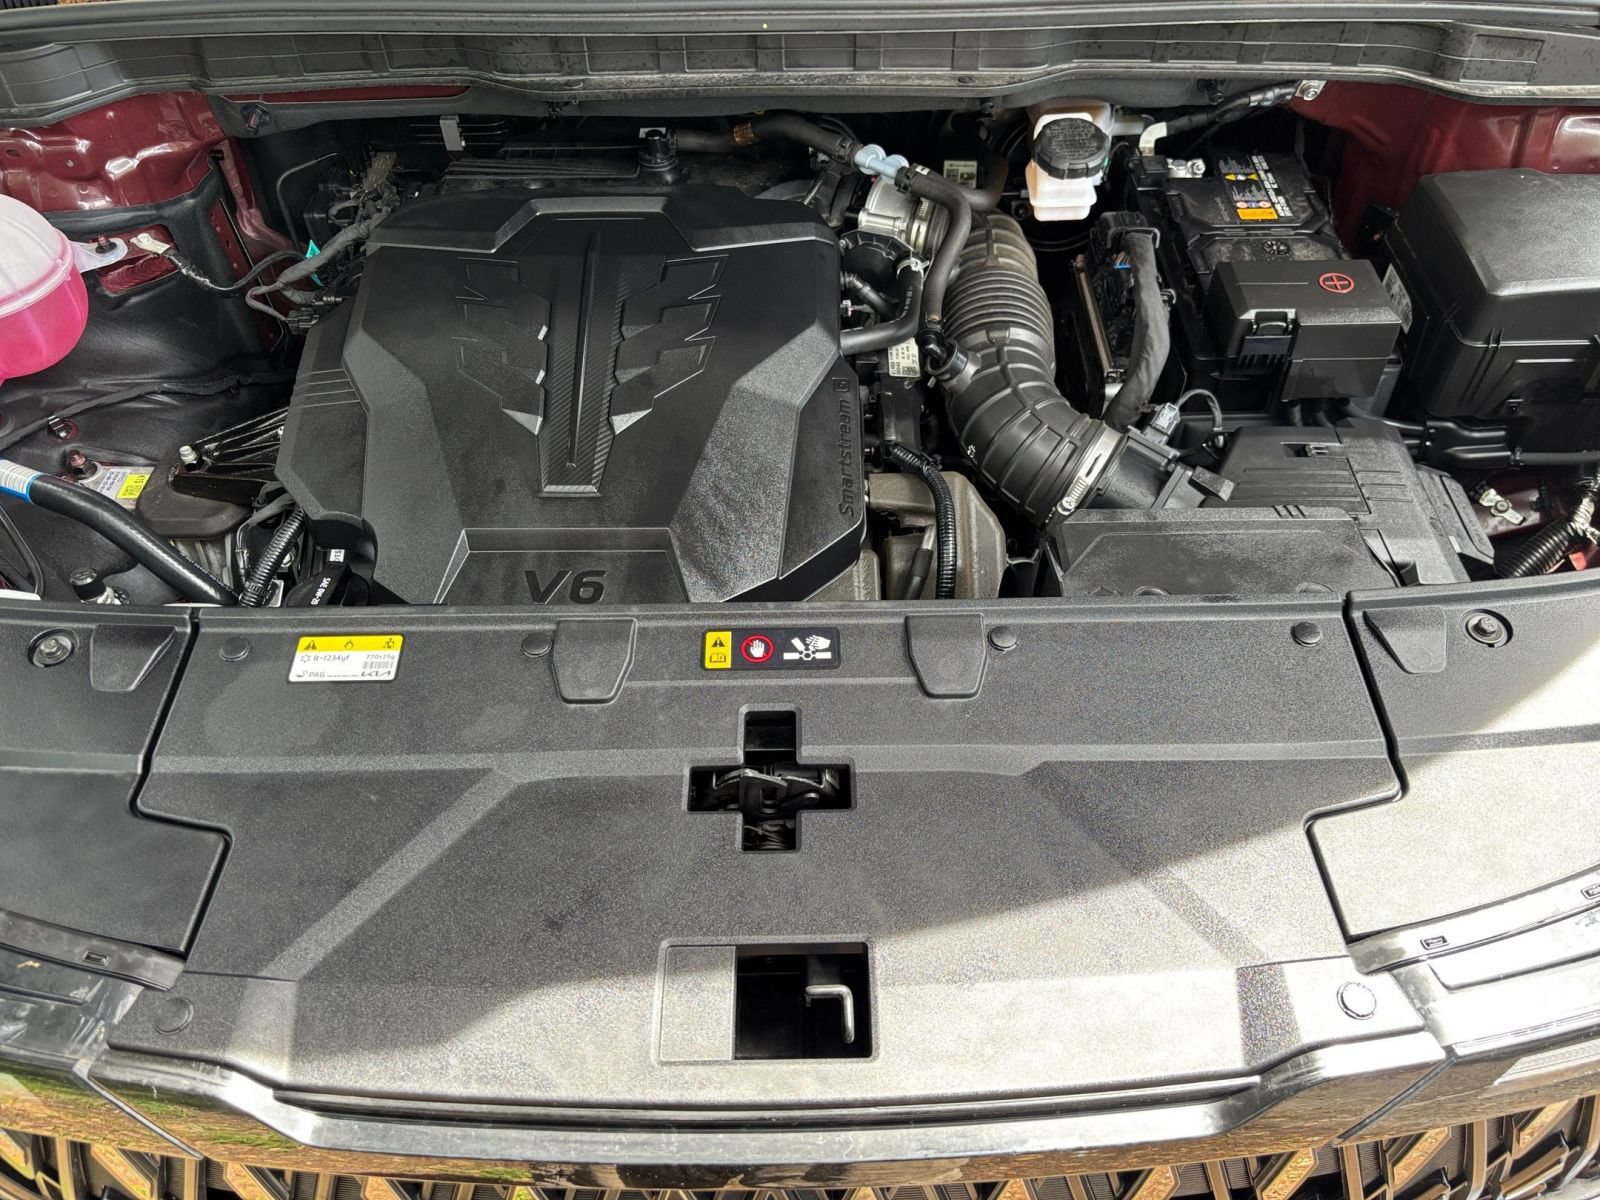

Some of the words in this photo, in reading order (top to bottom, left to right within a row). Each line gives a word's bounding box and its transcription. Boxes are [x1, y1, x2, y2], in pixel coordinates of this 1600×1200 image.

[838, 397, 854, 518] Smartstream
[320, 577, 331, 588] SAE
[524, 570, 606, 605] V6
[312, 654, 350, 663] R-1234yf
